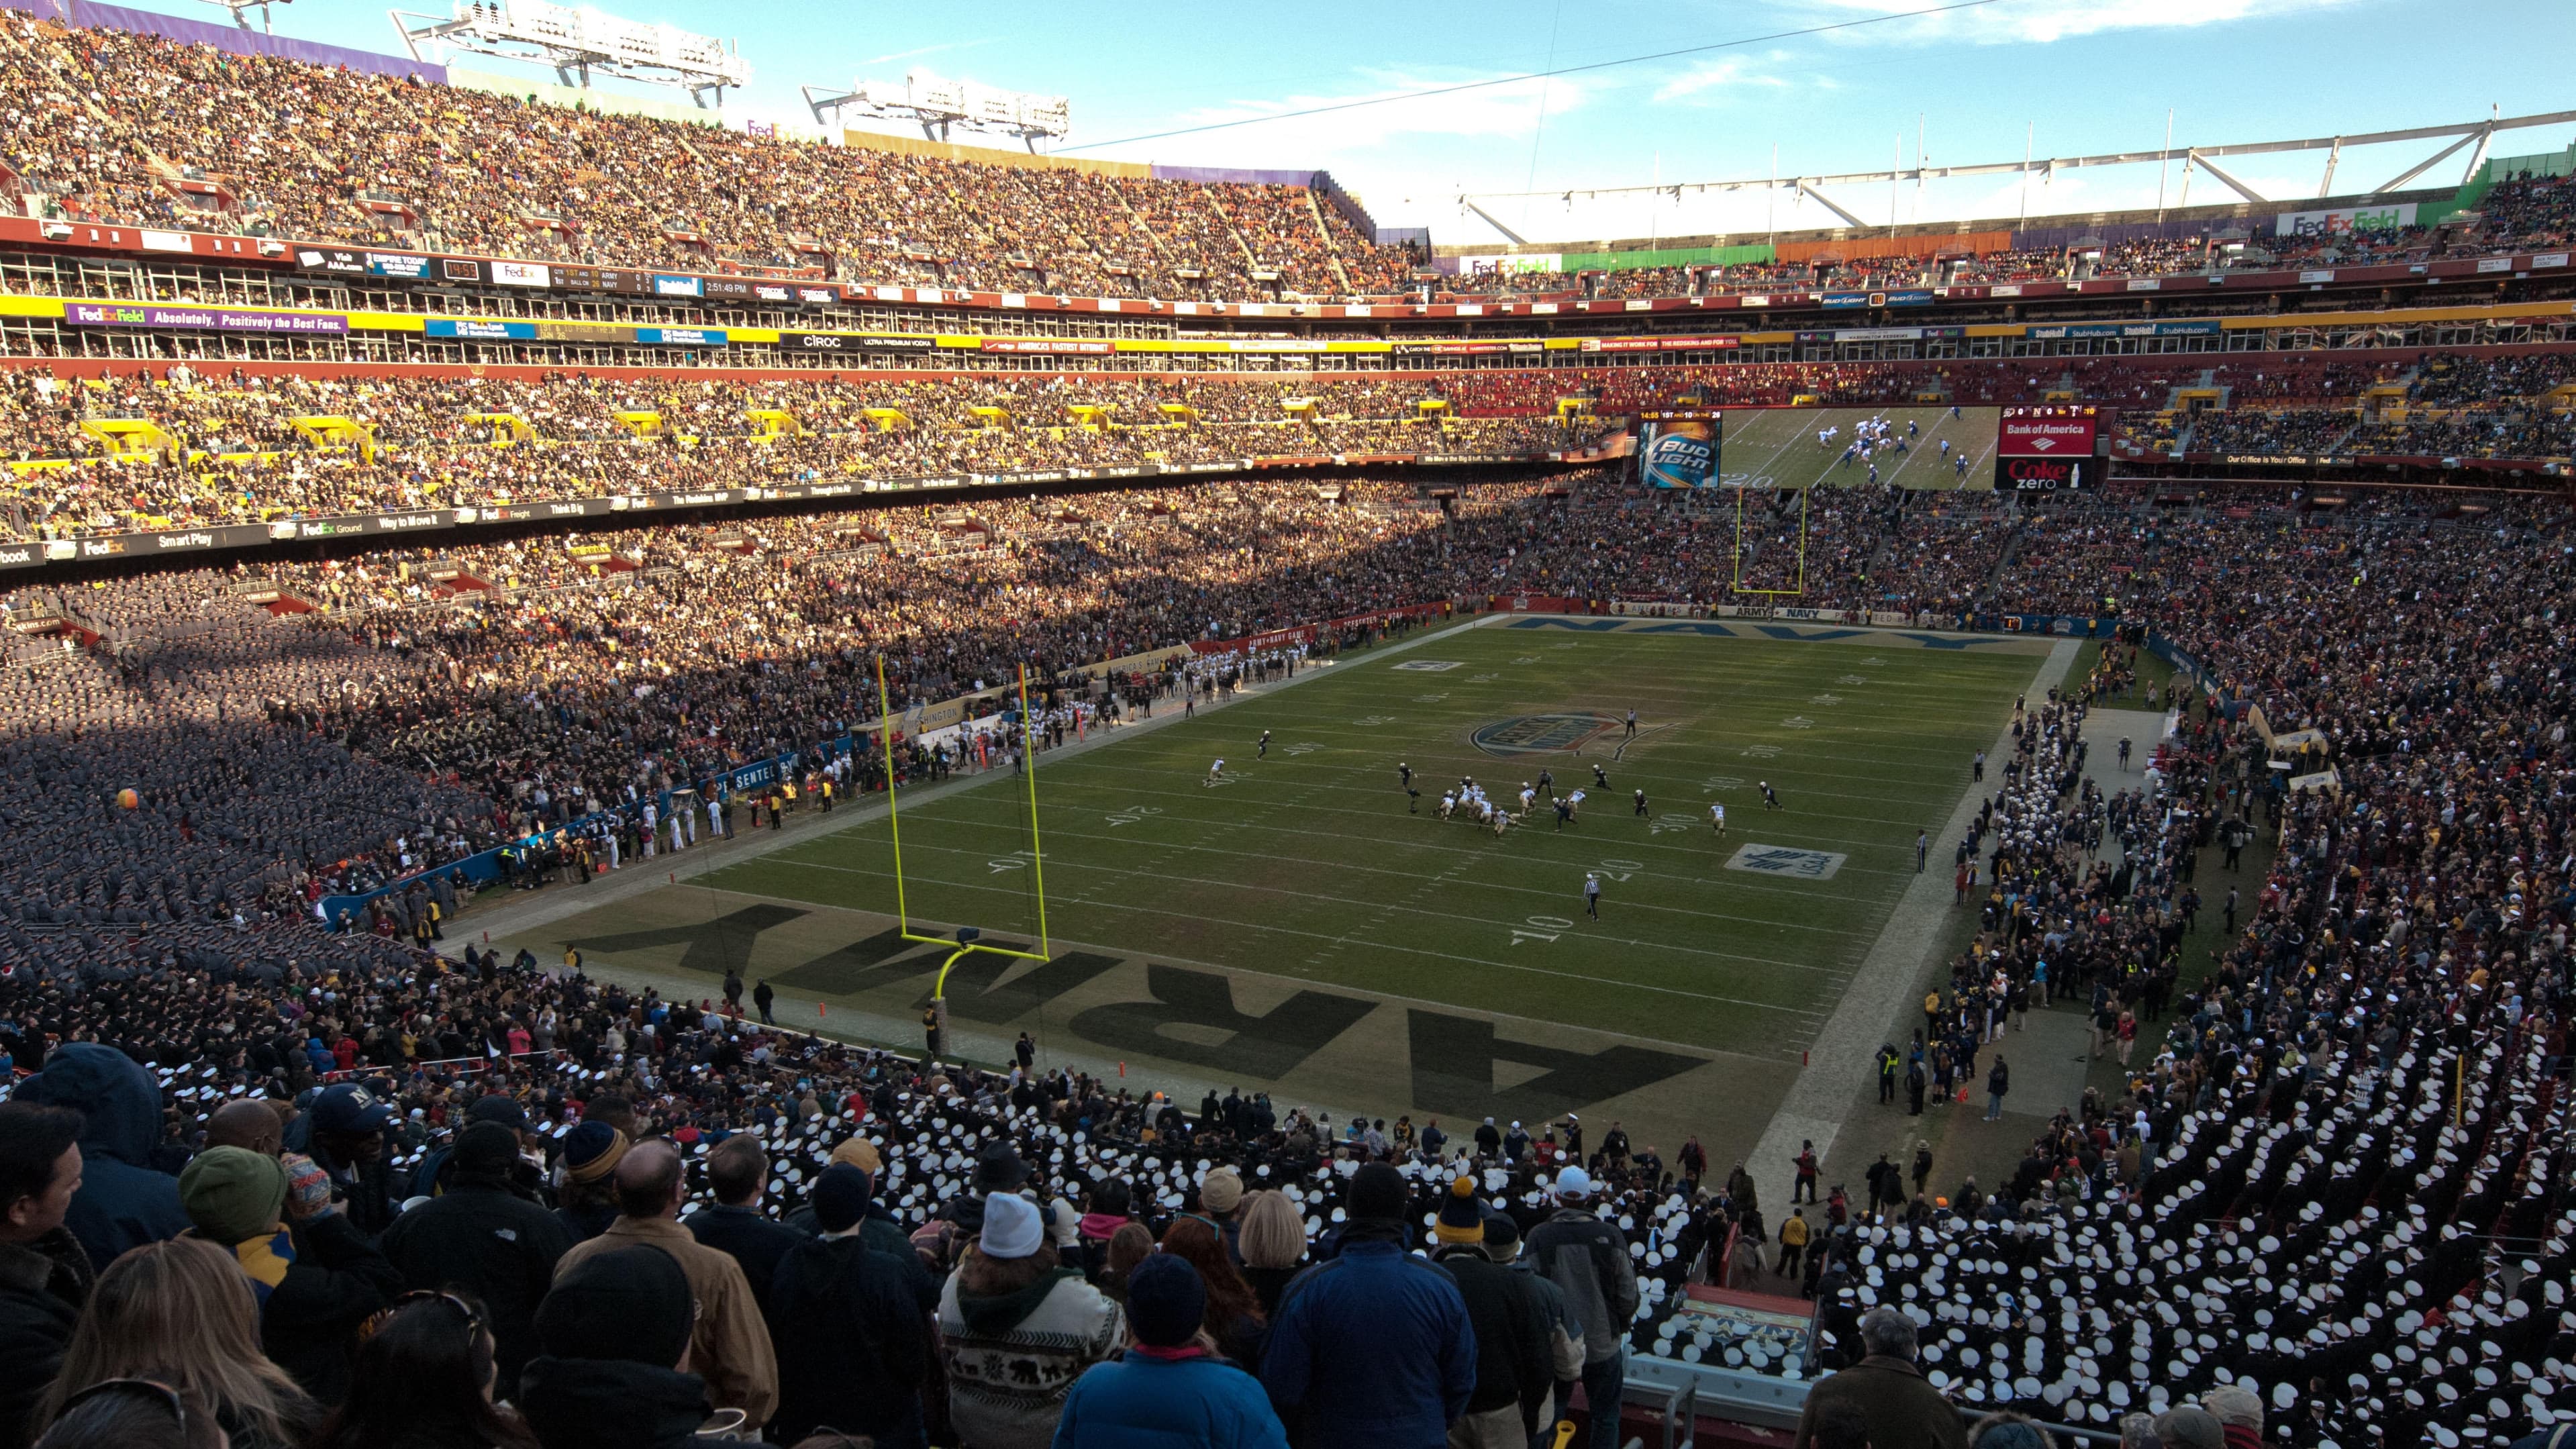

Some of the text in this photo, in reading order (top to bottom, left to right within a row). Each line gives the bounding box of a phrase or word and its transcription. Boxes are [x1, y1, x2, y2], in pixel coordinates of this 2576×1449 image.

[2293, 209, 2400, 236] FedExField
[403, 256, 428, 266] TODAY
[1472, 258, 1549, 274] FedExField
[505, 266, 535, 278] FedEx
[601, 272, 617, 280] ARMY
[554, 277, 564, 285] 1ST
[707, 283, 747, 293] 2:51:49 PM
[1841, 296, 1867, 304] LIGHT
[77, 307, 342, 331] FedExField Absolutely, Positively the Best Fans.
[2036, 326, 2067, 338] StubHub!
[2124, 323, 2157, 336] StubHub!
[2007, 424, 2084, 434] Bank of America
[1660, 440, 1711, 458] BUD
[1651, 452, 1711, 469] LIGHT
[2008, 458, 2068, 480] Coke
[2016, 478, 2057, 489] zero
[632, 497, 656, 508] FedEx
[673, 495, 685, 505] The
[764, 489, 785, 499] FedEx
[481, 503, 584, 520] FedEx Freight Think Big
[302, 521, 335, 536] FedEx
[336, 523, 362, 534] Ground
[379, 517, 397, 530] Way
[397, 516, 406, 527] to
[407, 515, 431, 527] Move
[84, 533, 212, 556] FedEx Smart Play
[1736, 607, 1820, 617] ARMY NAVY
[1288, 630, 1305, 640] GAME
[1507, 617, 2000, 650] NAVY
[1511, 915, 1574, 943] 10
[556, 902, 1714, 1123] ARMY
